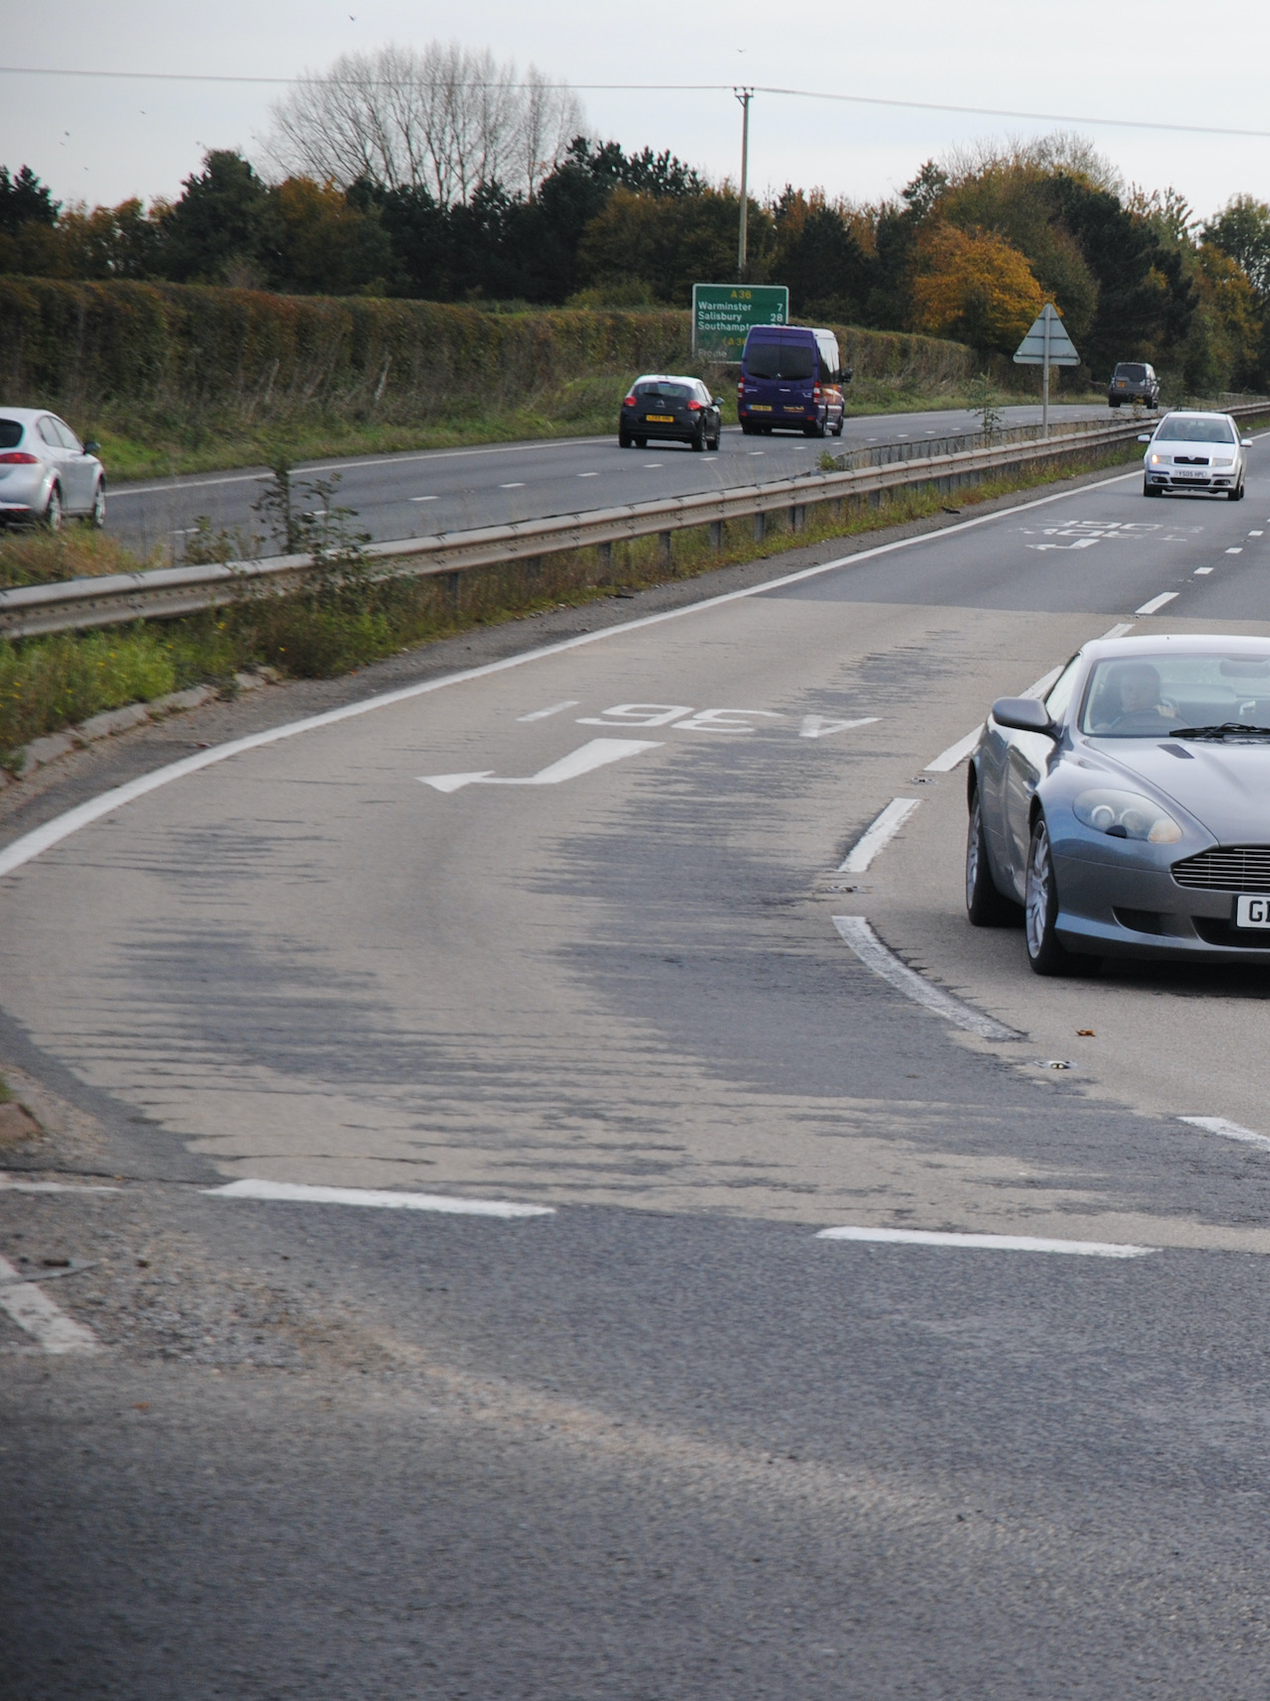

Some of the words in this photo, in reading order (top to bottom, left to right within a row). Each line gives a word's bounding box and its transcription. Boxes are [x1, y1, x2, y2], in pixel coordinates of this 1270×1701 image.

[730, 290, 752, 299] A36
[698, 301, 752, 312] Warminster
[777, 303, 784, 312] 7
[698, 311, 742, 322] Salisbury
[770, 313, 784, 322] 28
[698, 322, 752, 333] Southampt
[515, 700, 884, 738] A361
